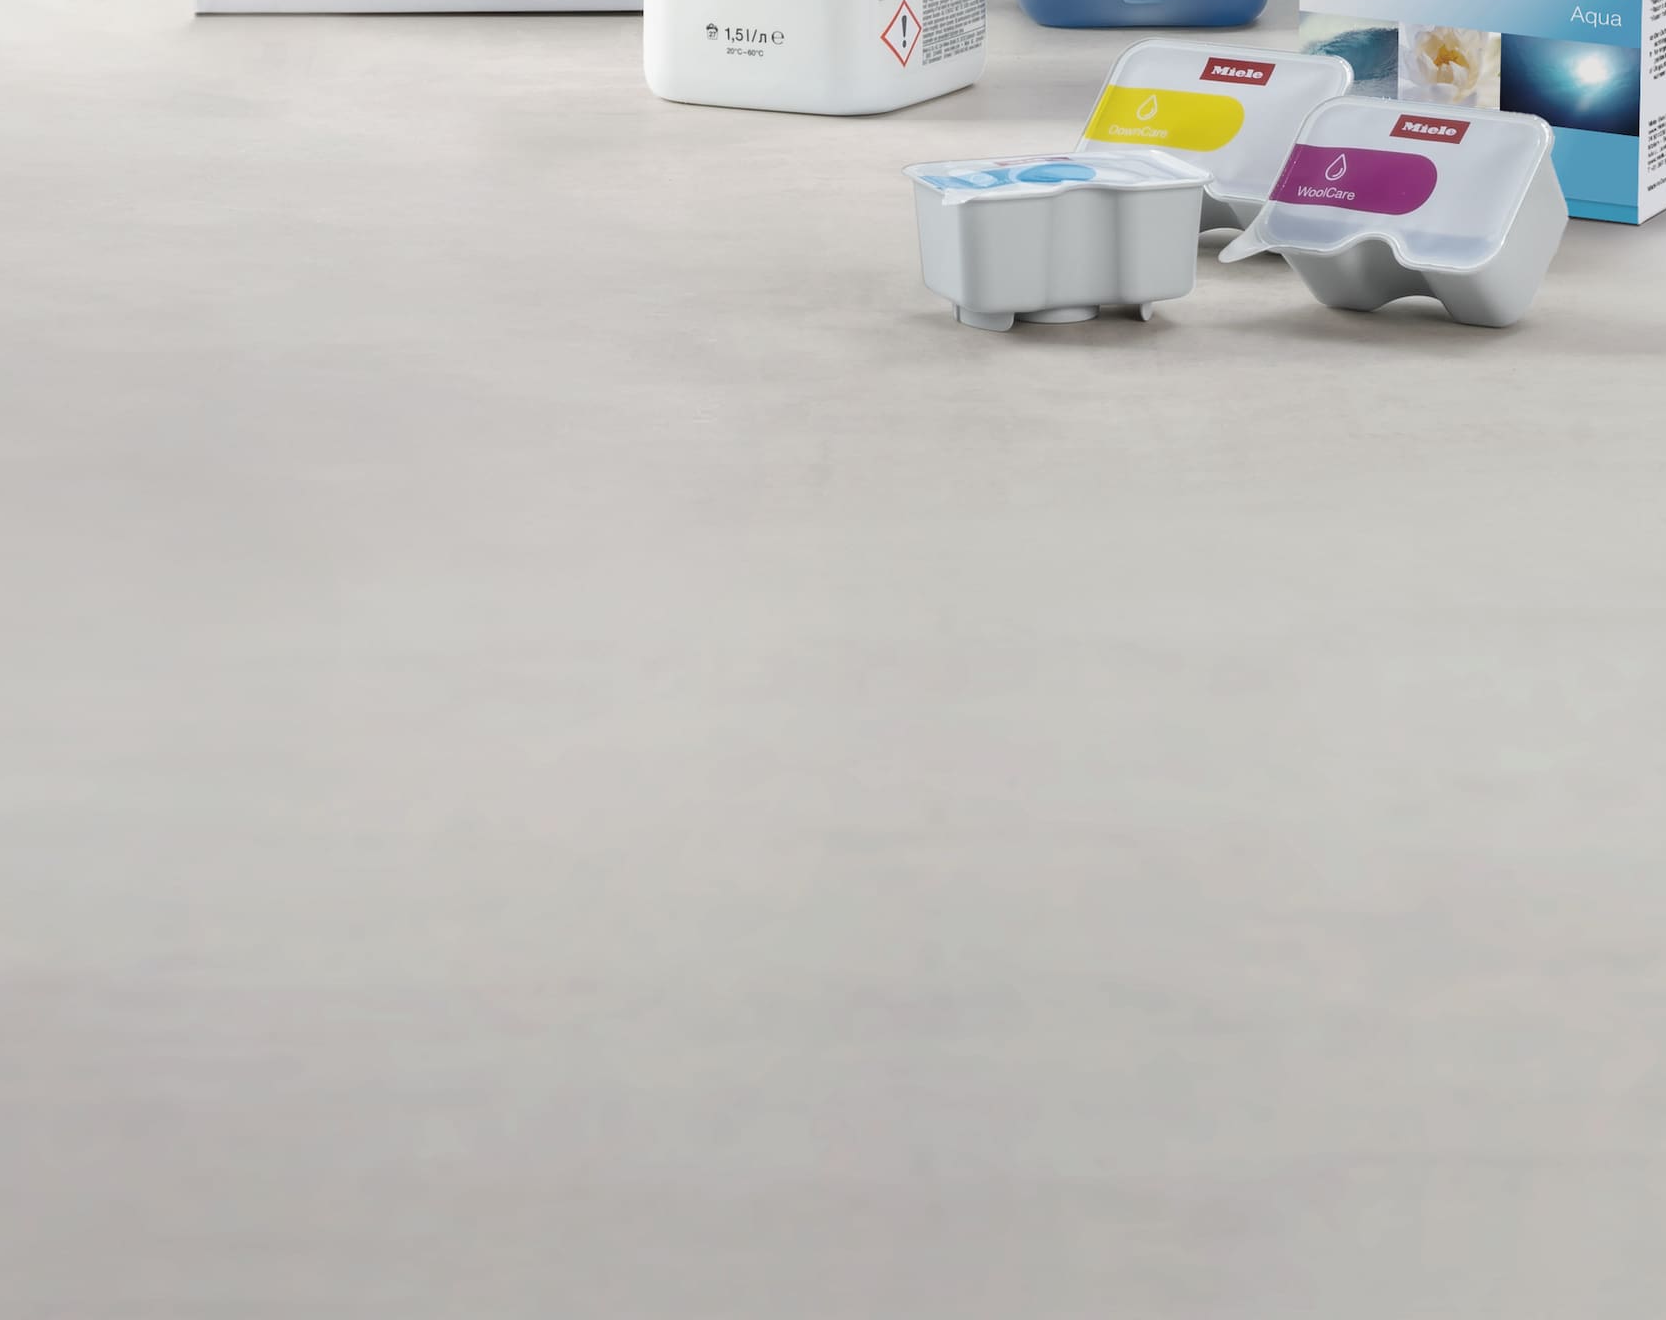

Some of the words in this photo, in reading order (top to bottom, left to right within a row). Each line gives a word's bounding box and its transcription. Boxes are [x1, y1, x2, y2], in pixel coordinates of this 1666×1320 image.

[1570, 5, 1622, 29] Aqua
[724, 27, 744, 43] 1,5
[1211, 65, 1264, 80] Miele
[1402, 121, 1457, 137] Miele
[1297, 185, 1356, 201] WoolCare
